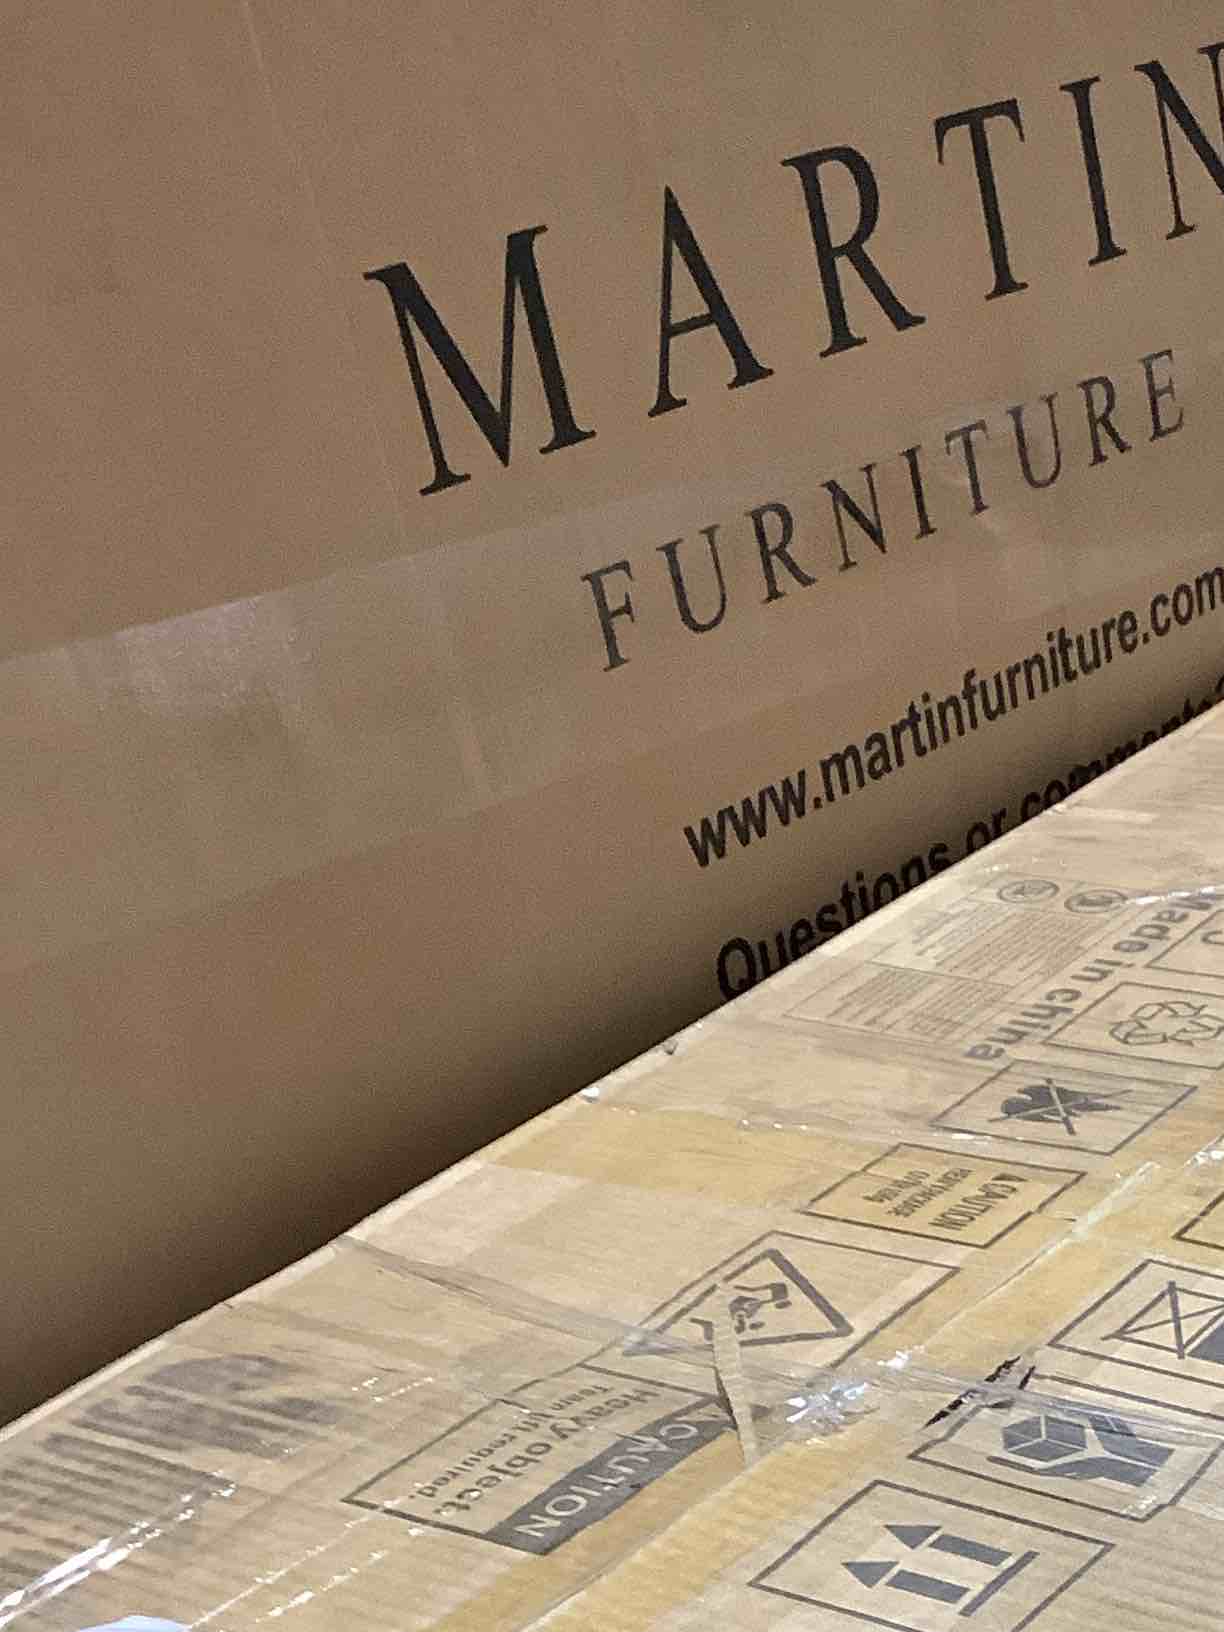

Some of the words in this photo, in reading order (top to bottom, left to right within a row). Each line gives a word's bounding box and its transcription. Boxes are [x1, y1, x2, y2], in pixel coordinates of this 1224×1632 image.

[581, 347, 1186, 673] FURNITURE
[963, 987, 1082, 1061] china
[549, 1387, 660, 1442] Heavy
[513, 1420, 700, 1538] CAUTION
